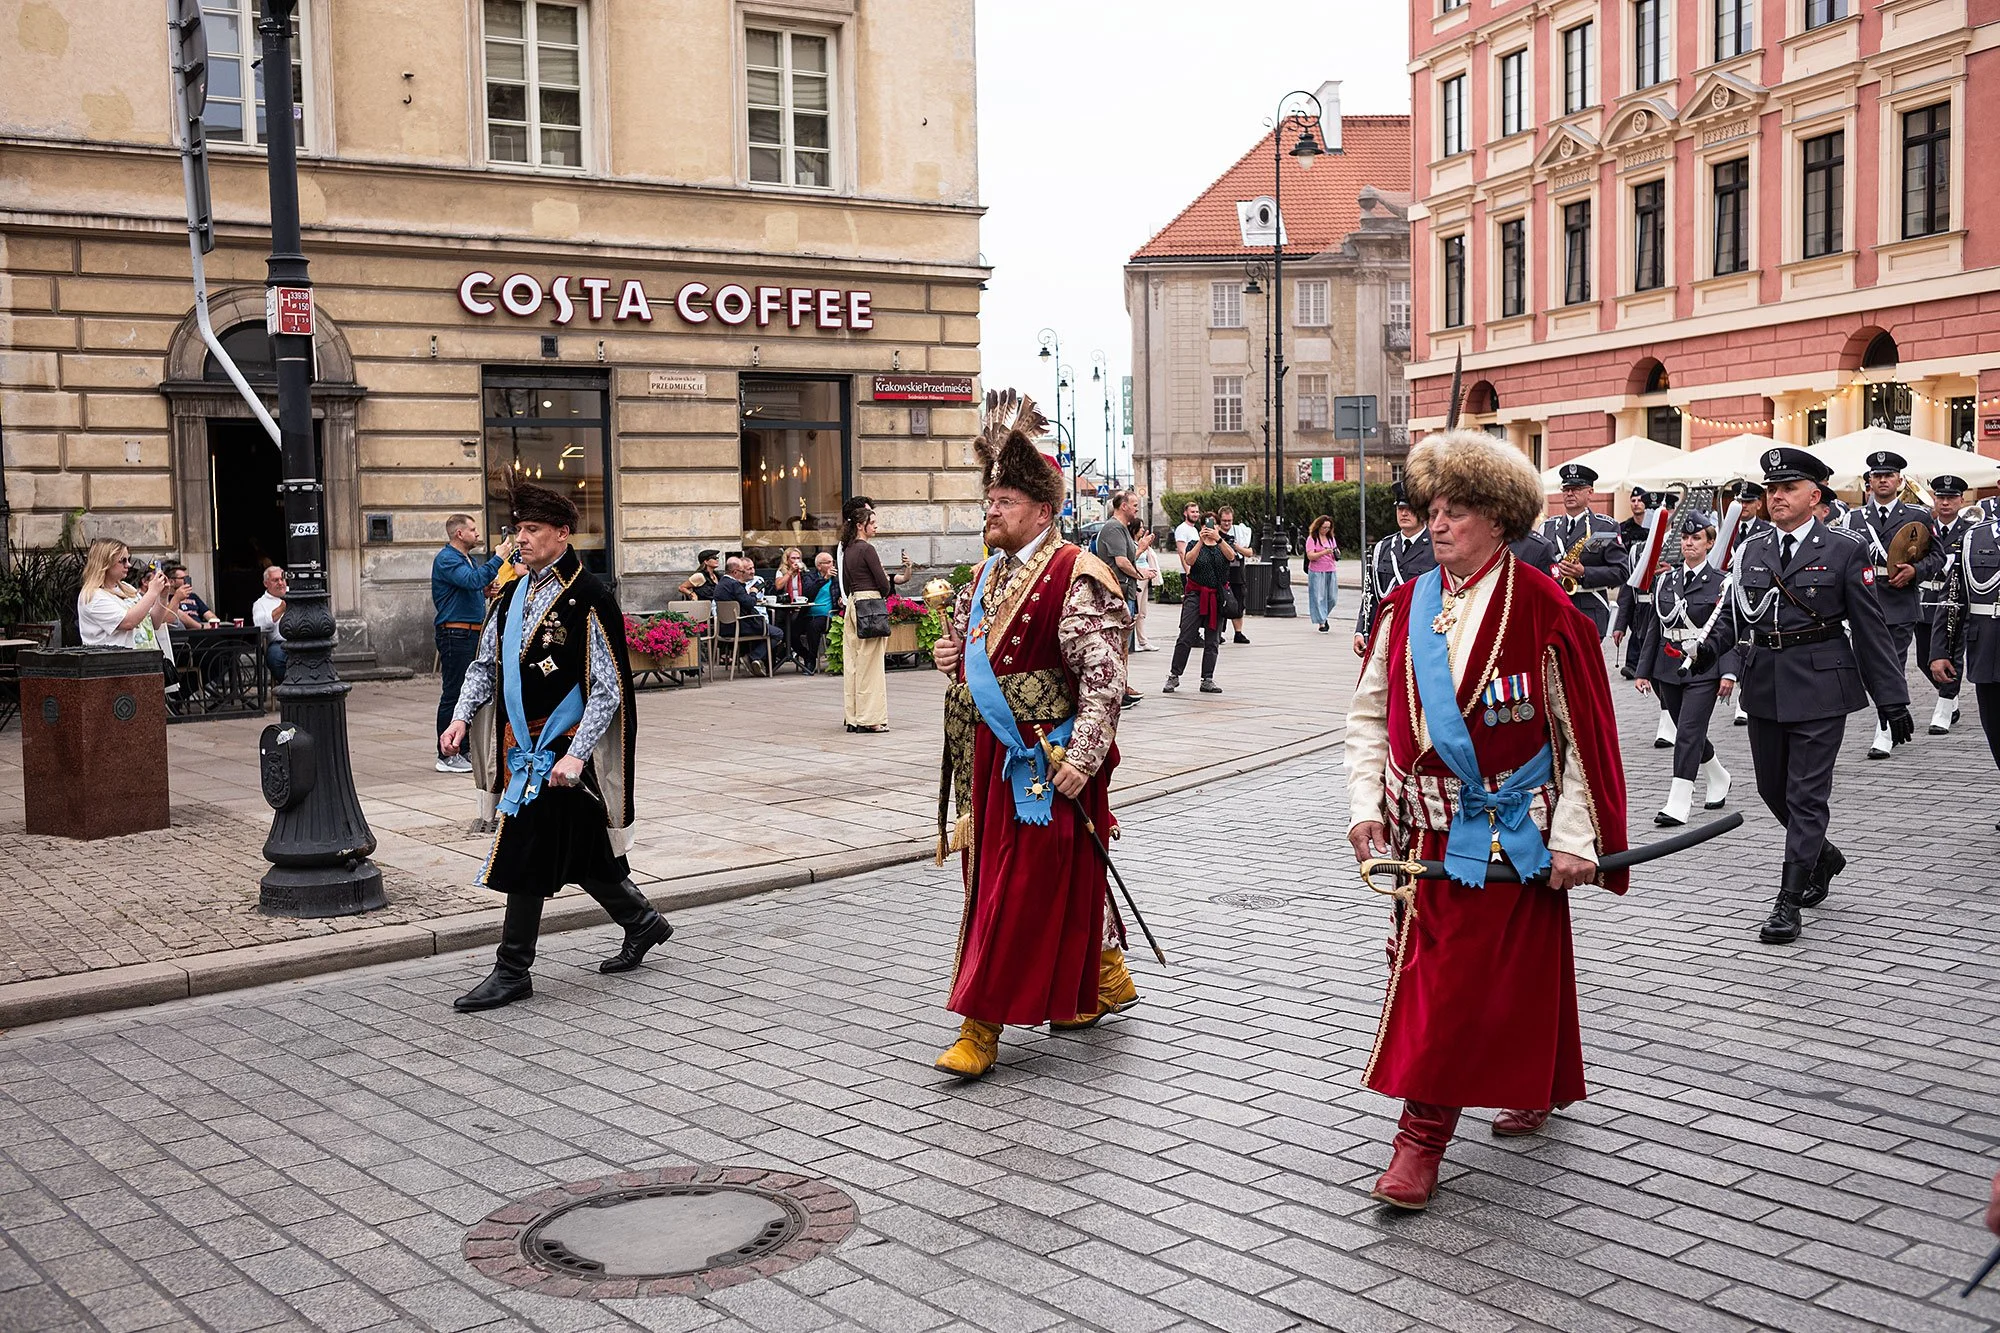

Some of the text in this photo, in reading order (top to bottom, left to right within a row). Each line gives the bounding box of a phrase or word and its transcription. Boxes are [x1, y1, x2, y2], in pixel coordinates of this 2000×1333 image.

[281, 293, 291, 307] H
[457, 270, 875, 331] COSTA COFFEE
[875, 381, 922, 392] Krakowskie
[923, 381, 972, 394] Przedmieście
[1123, 384, 1132, 428] PTTK
